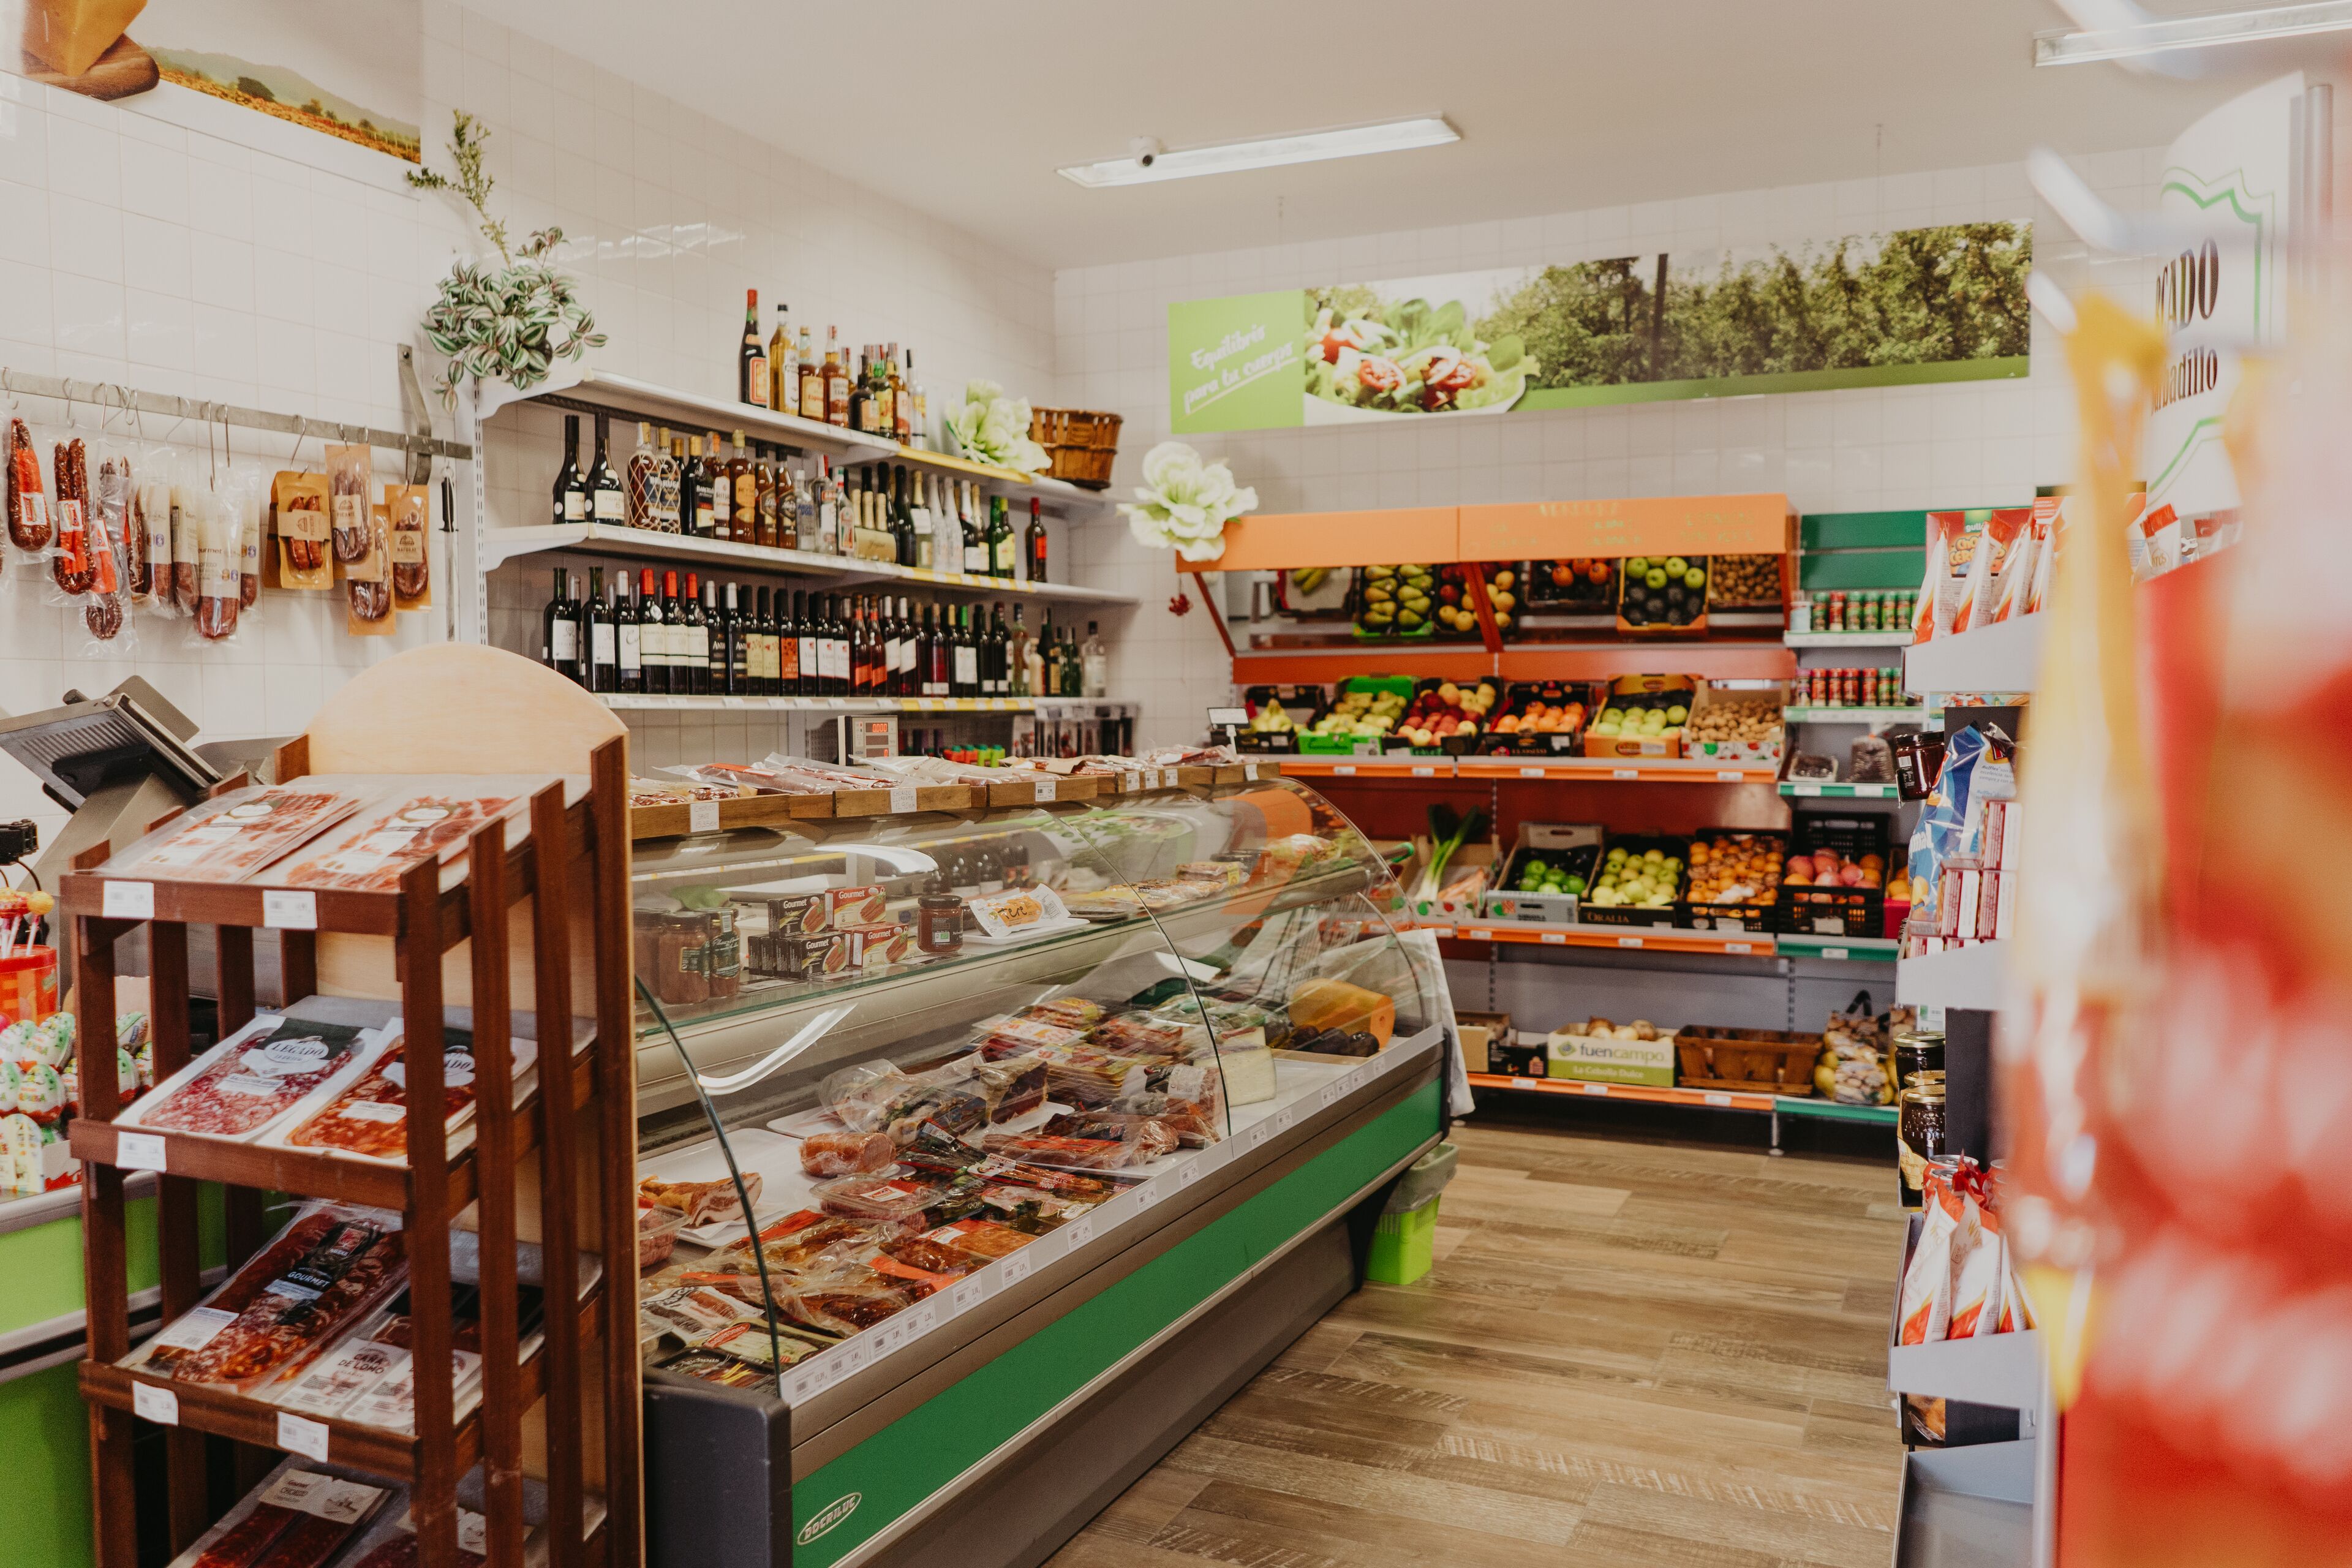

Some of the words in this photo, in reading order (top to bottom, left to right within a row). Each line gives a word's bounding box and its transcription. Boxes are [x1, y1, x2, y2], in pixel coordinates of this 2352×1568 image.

[1190, 324, 1265, 372] Equilibrio
[1183, 380, 1219, 415] para
[1221, 369, 1240, 387] tu
[1243, 341, 1294, 372] cuerpo
[839, 889, 865, 899] Gourmet
[783, 899, 807, 909] Gourmet
[868, 930, 891, 940] Gourmet
[805, 939, 829, 949] Gourmet
[271, 1042, 325, 1056] LEGADO
[1580, 1042, 1664, 1063] fuencampo
[1572, 1065, 1584, 1074] La
[1585, 1066, 1618, 1077] Cebolla
[1618, 1069, 1645, 1078] Dulce
[287, 1271, 332, 1288] GOURMET
[338, 1359, 351, 1368] DE
[353, 1362, 385, 1375] LOMO
